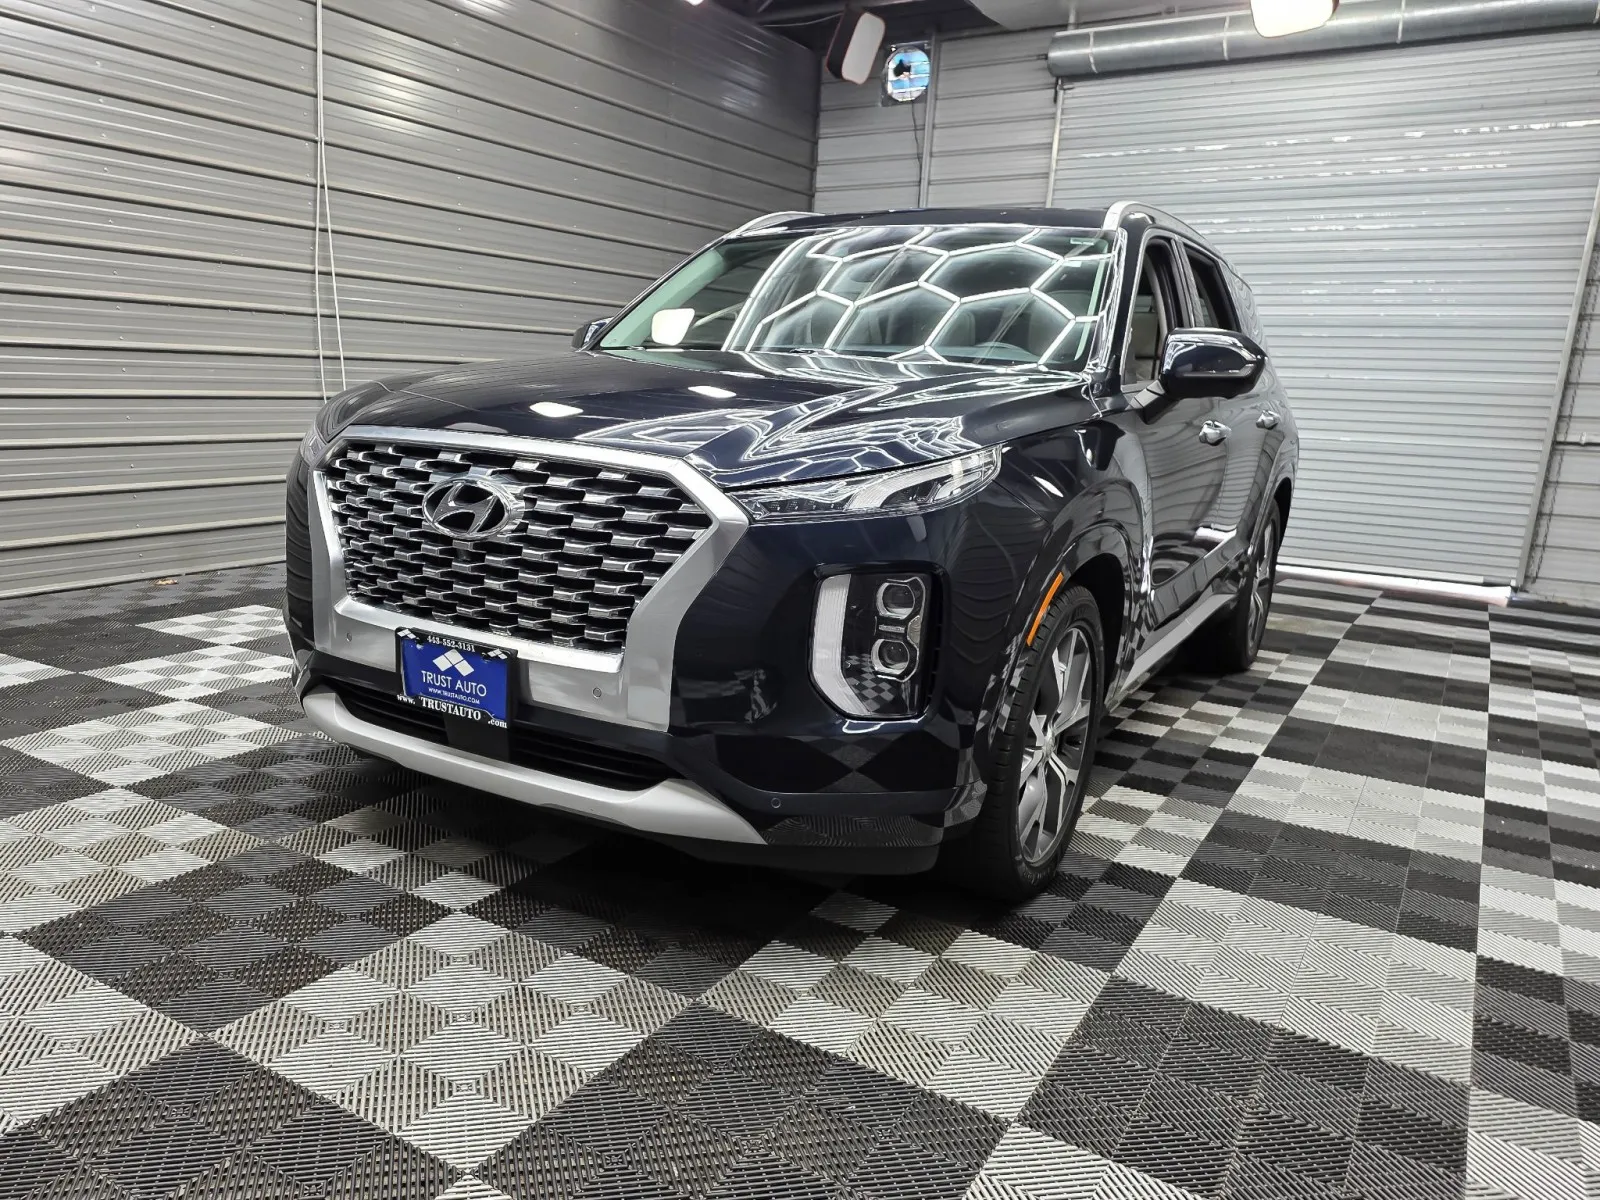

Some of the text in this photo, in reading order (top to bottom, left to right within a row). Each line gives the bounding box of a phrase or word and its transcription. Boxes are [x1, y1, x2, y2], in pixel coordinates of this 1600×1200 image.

[426, 635, 475, 652] 443-552-3131
[421, 670, 487, 697] TRUST AUTO
[428, 688, 480, 704] WWW.TRUSTAUTO.COM
[396, 693, 507, 729] www. TRUSTAUTO .com
